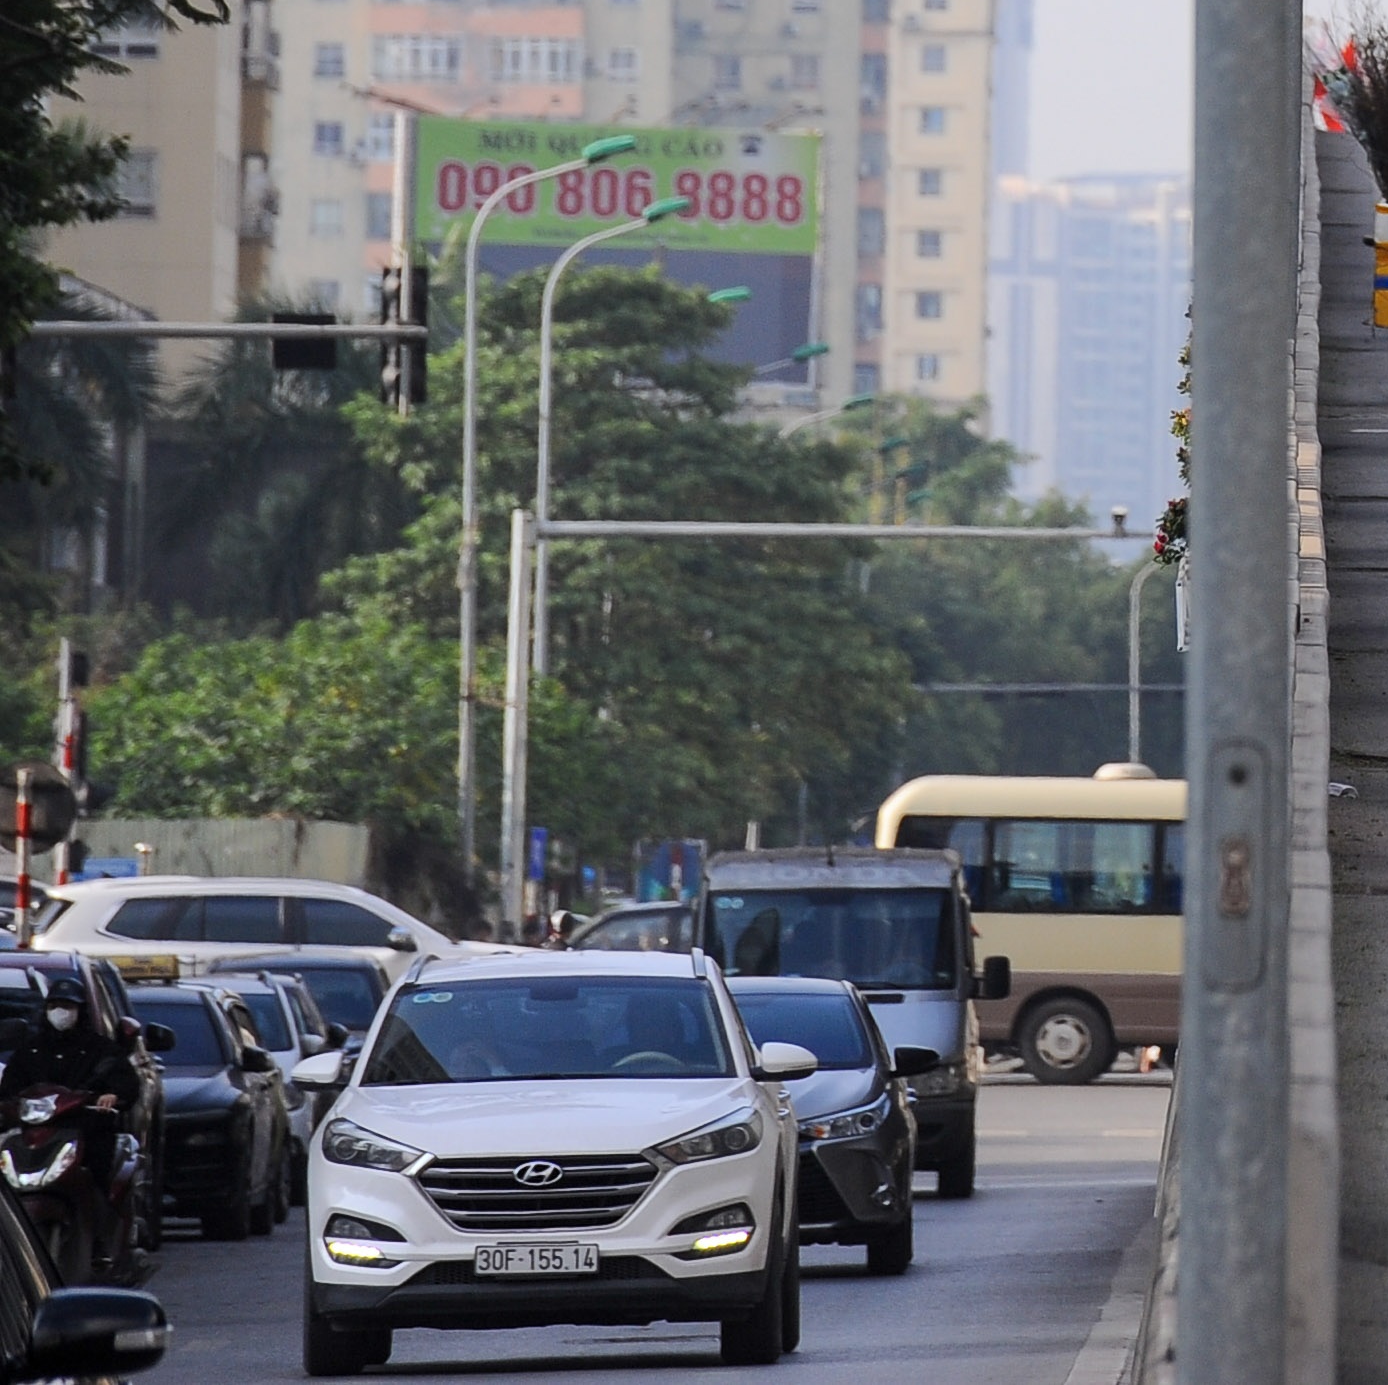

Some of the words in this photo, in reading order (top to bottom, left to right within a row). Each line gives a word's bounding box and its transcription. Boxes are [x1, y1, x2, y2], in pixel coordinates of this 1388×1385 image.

[437, 161, 536, 214] 090
[556, 165, 654, 218] 806
[675, 170, 803, 223] 8888
[478, 1247, 595, 1272] 30F-155.14
